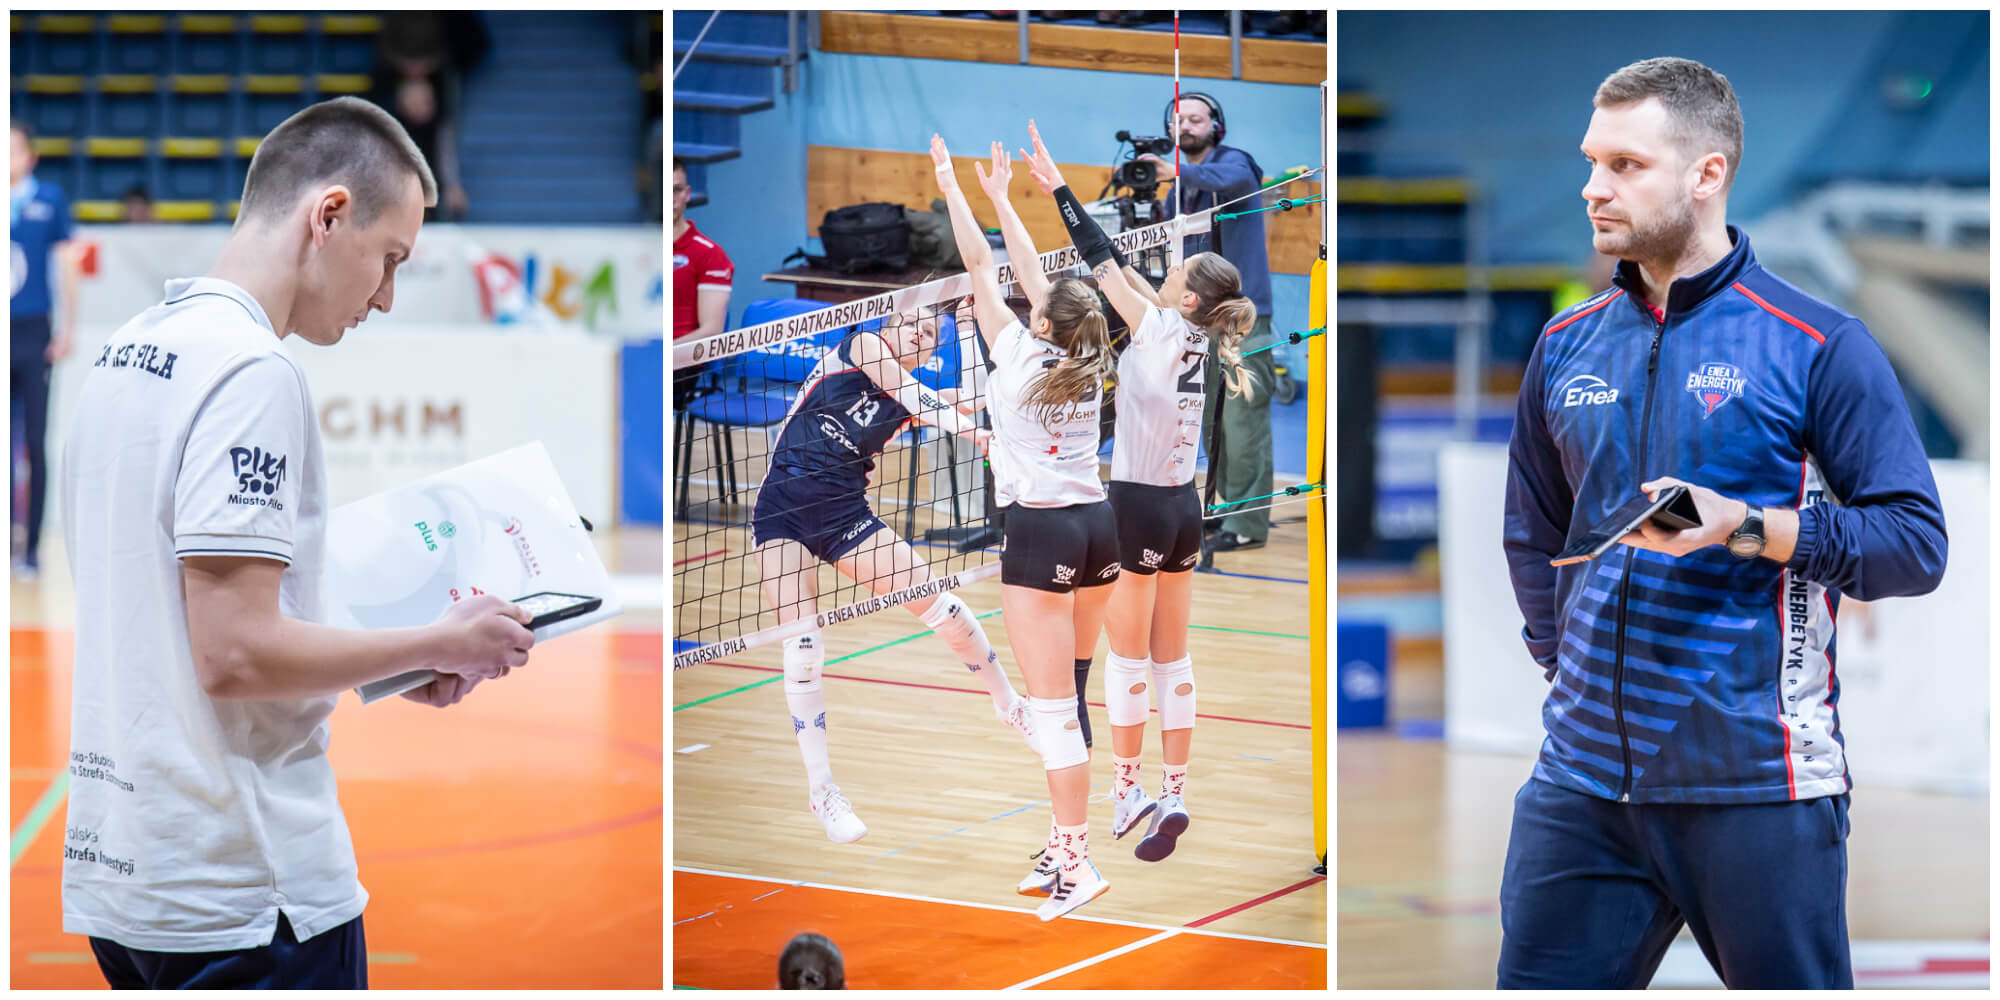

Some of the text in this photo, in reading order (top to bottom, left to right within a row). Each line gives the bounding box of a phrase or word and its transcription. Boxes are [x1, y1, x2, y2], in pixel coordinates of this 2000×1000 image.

[1141, 226, 1167, 247] PIŁA
[708, 295, 894, 358] ENEA KLUB SIATKARSKI PIŁA
[1687, 372, 1746, 395] ENERGETYK
[1707, 366, 1730, 378] ENEA
[845, 391, 880, 427] 13
[1564, 387, 1619, 408] Enea
[228, 494, 266, 506] Miasto
[414, 521, 438, 552] plus
[827, 575, 961, 625] ENEA KLUB SIATKARSKI PIŁA
[673, 637, 747, 671] ATKARSKI PIŁA
[79, 764, 105, 780] Strefa
